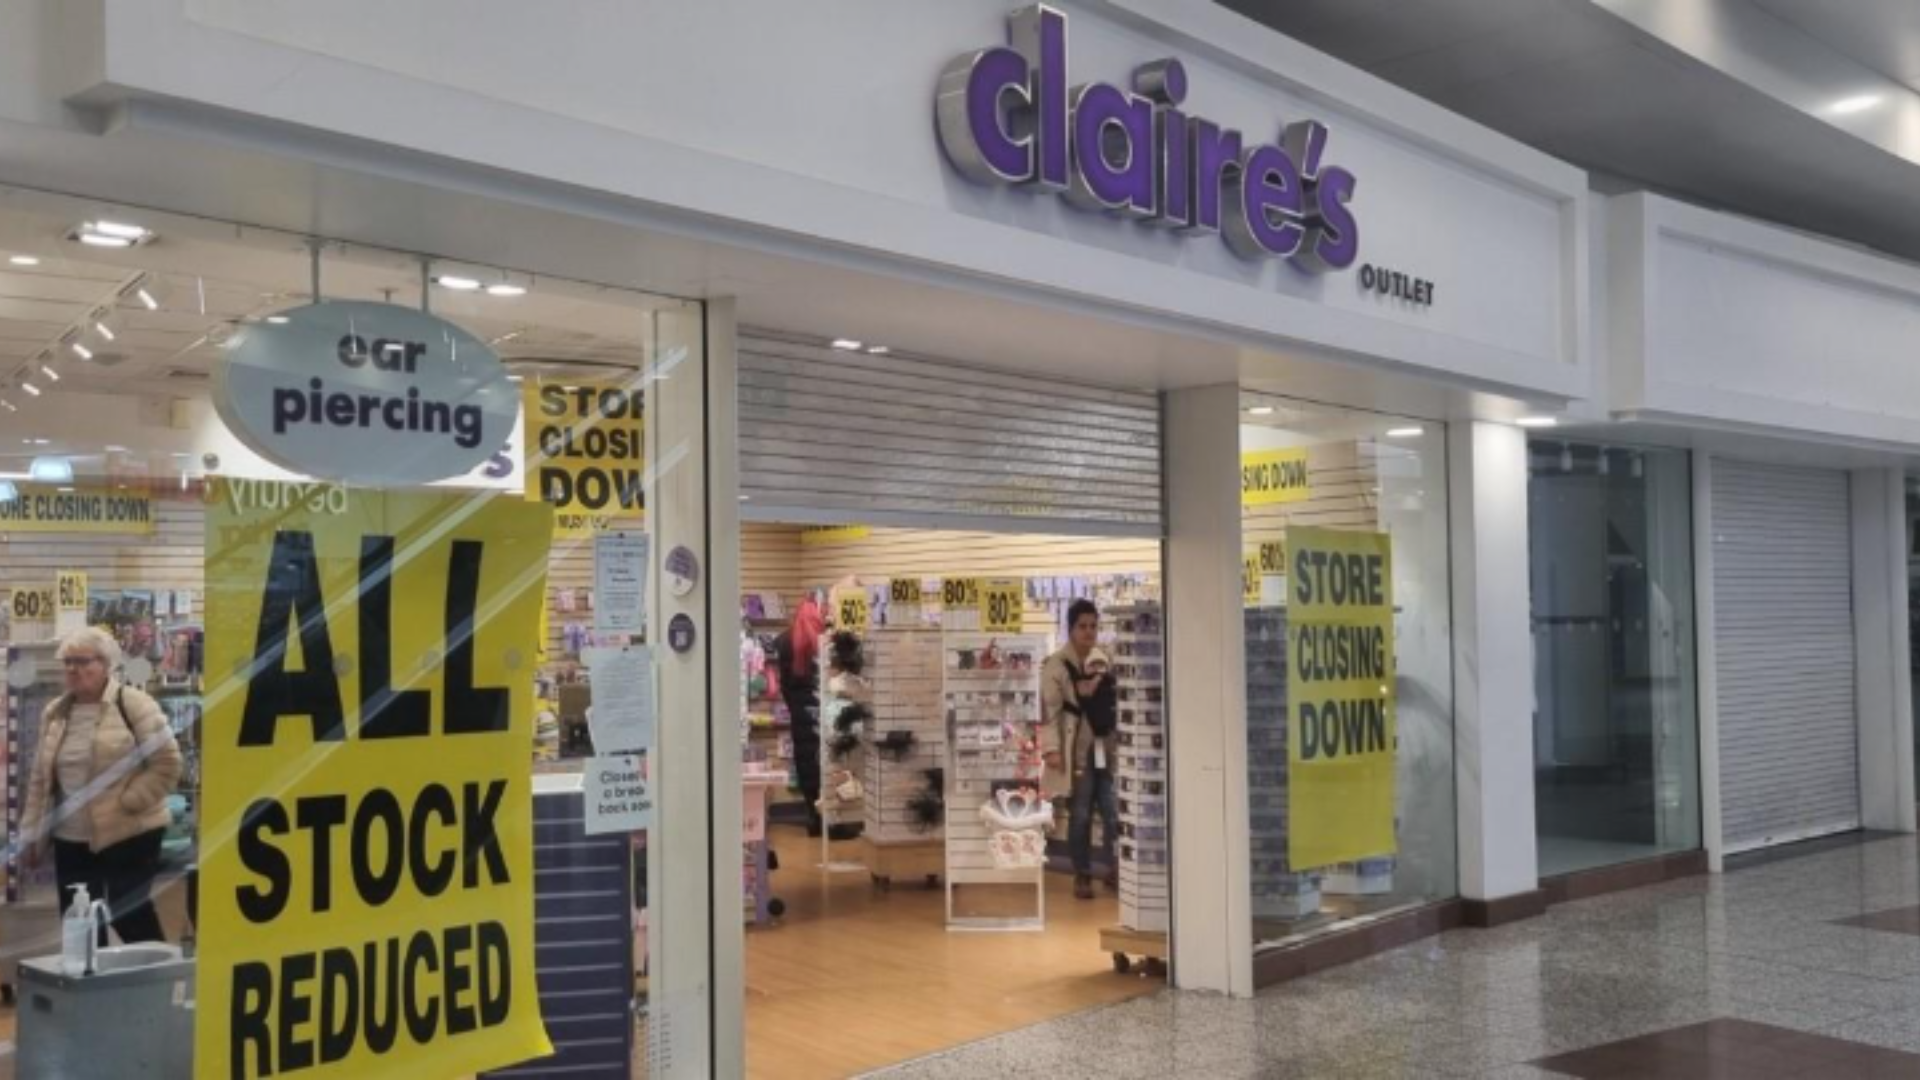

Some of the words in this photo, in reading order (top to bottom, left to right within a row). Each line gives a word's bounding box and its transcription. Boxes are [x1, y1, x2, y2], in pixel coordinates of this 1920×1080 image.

[945, 4, 1358, 270] claire's
[1359, 262, 1434, 307] OUTLET
[338, 334, 426, 373] ear
[272, 377, 483, 449] piercing
[539, 424, 645, 460] CLOSI
[1269, 459, 1307, 490] DOWN
[35, 495, 102, 521] CLOSING
[106, 497, 150, 522] DOWN
[1295, 549, 1384, 605] STORE
[236, 530, 511, 748] ALL
[1297, 624, 1385, 682] CLOSING
[1299, 698, 1386, 760] DOWN
[235, 780, 511, 924] STOCK
[228, 920, 512, 1080] REDUCED
